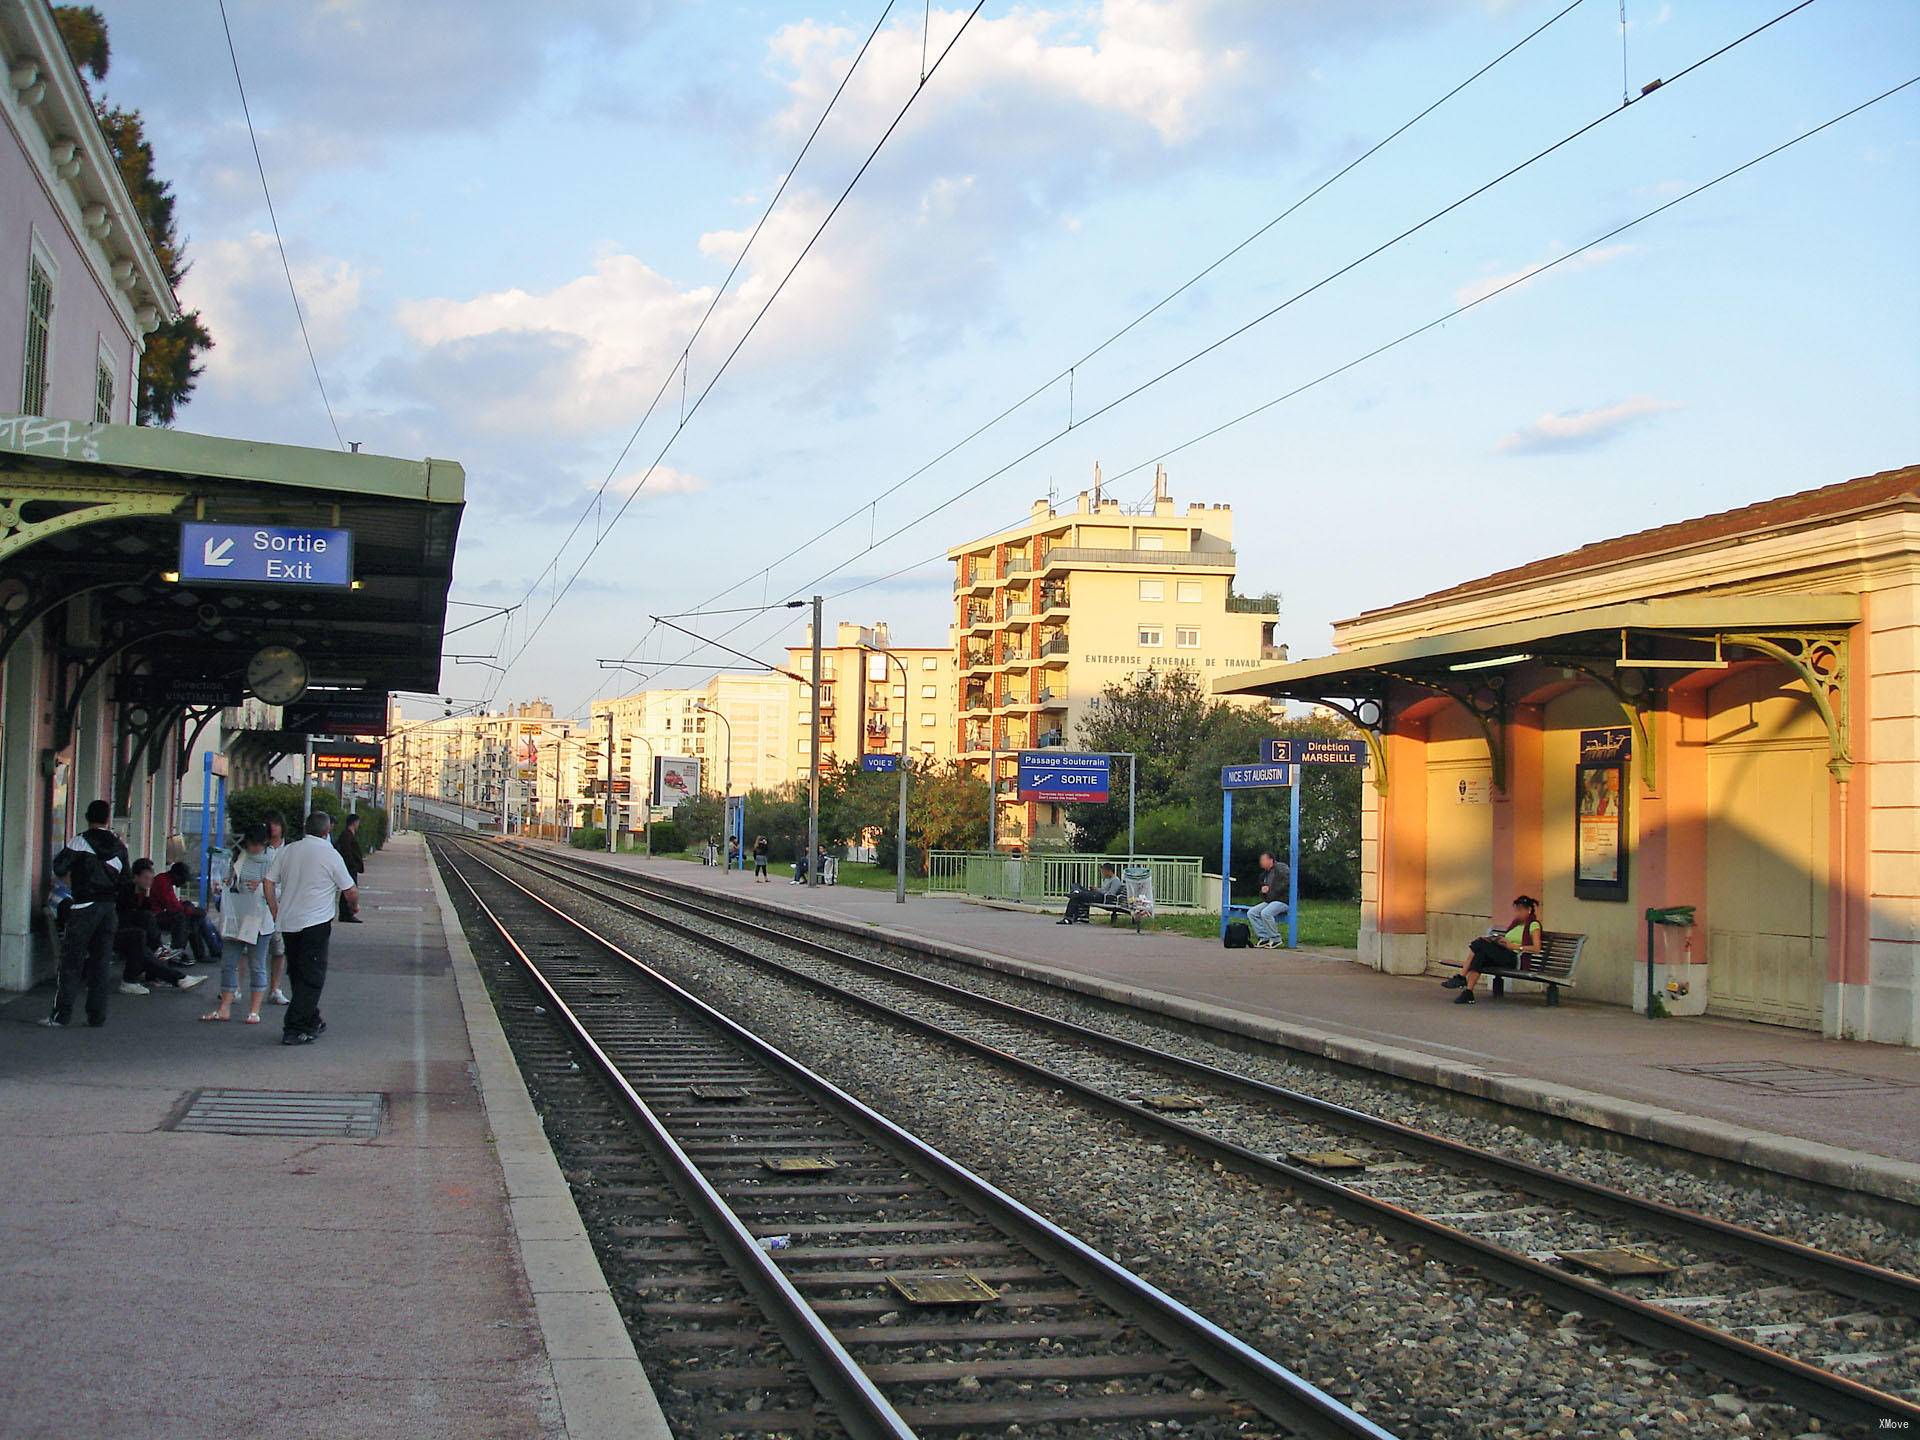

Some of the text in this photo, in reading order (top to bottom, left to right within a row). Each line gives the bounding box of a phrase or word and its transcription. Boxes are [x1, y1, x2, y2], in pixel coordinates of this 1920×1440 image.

[253, 531, 327, 553] Sortie
[266, 559, 312, 580] Exit
[1085, 654, 1262, 668] ENTREPRISE GENERALE DE TRAVAUX
[172, 679, 224, 689] Direction
[1308, 741, 1350, 752] Direction
[1278, 748, 1286, 759] 2
[1301, 753, 1357, 763] MARSEILLE
[868, 759, 886, 767] VOIE
[1025, 756, 1105, 766] Passage Souterrain
[1060, 775, 1098, 785] SORTIE
[1228, 768, 1283, 783] NICE ST AUGUSTIN
